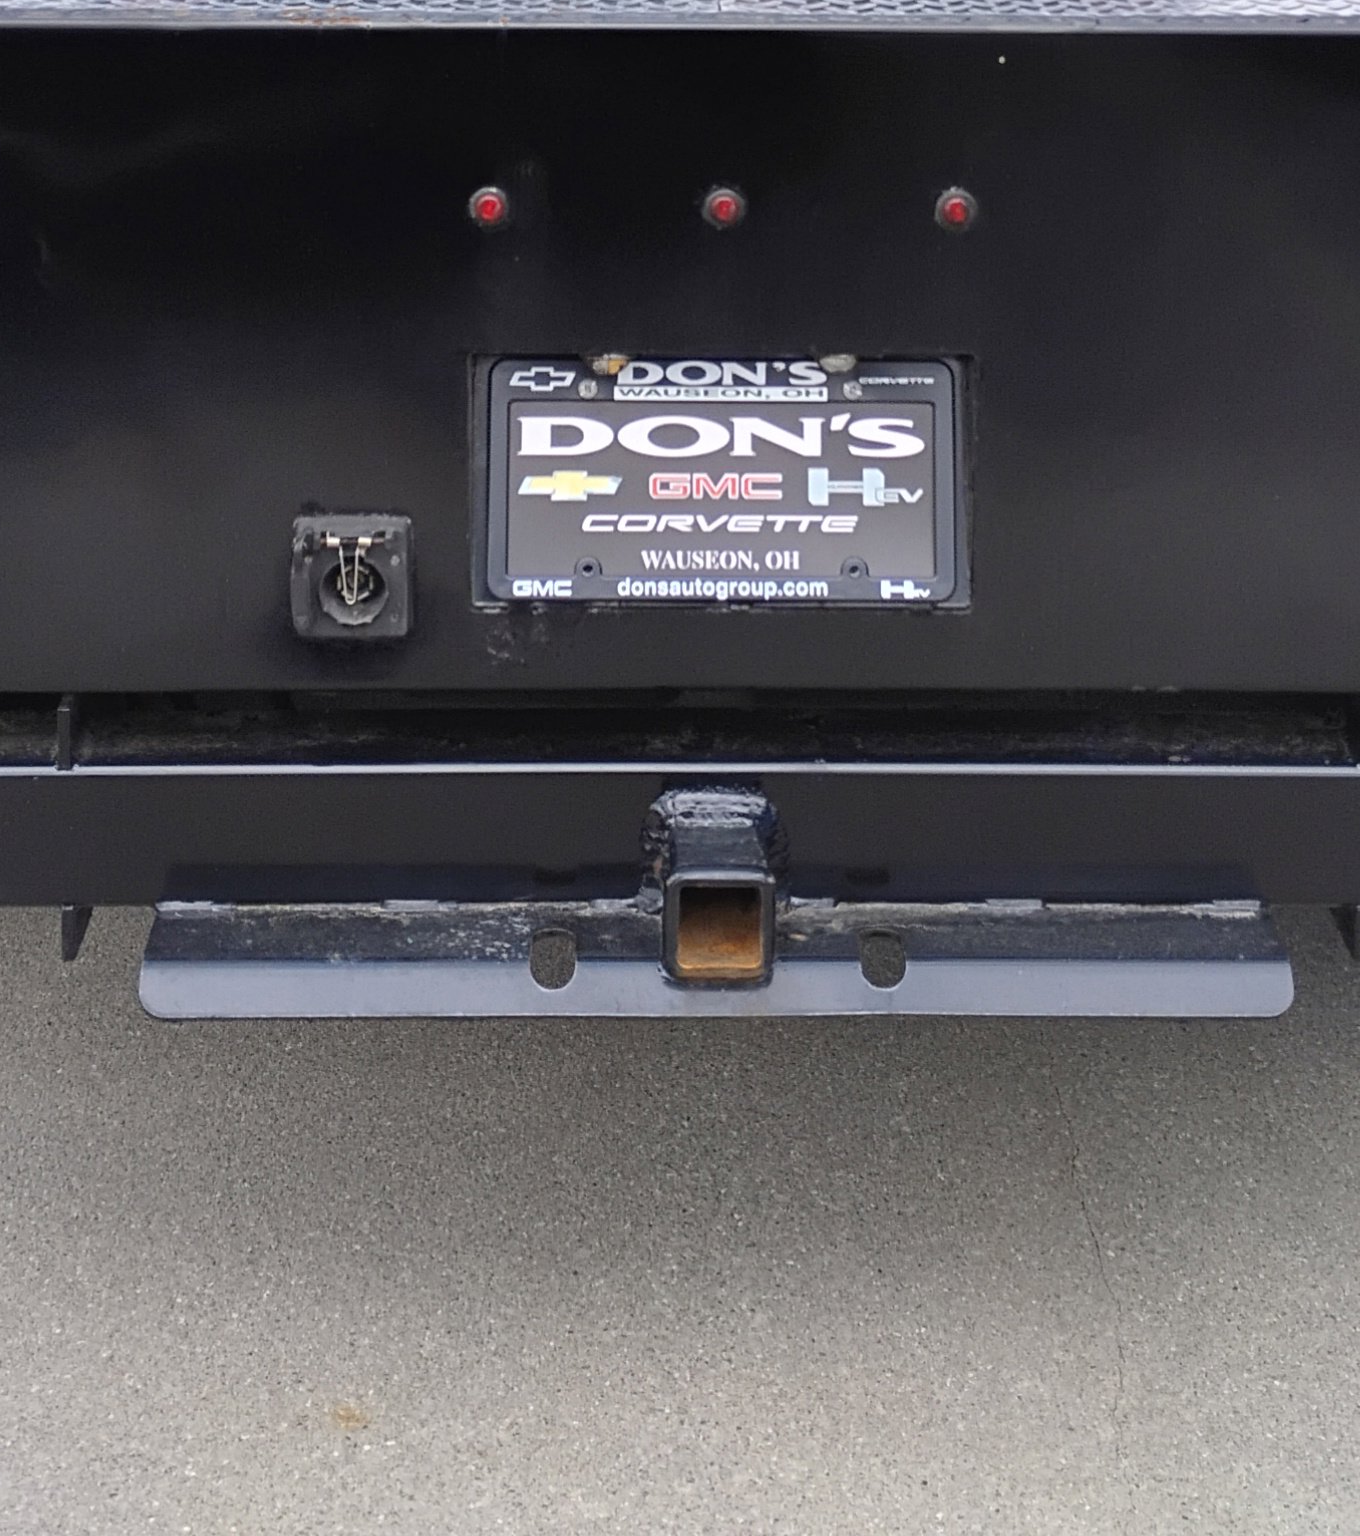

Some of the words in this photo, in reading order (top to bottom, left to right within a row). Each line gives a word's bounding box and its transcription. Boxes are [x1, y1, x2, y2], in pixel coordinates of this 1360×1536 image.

[617, 360, 828, 387] DON'S
[619, 387, 772, 400] WAUSEON,
[782, 387, 824, 400] OH
[517, 412, 925, 459] DON'S
[649, 473, 783, 501] GMC
[581, 514, 859, 533] CORVETTE
[641, 550, 760, 572] WAUSEON,
[765, 550, 801, 570] OH
[512, 579, 572, 597] GMC
[617, 577, 828, 600] donsautogroup.com
